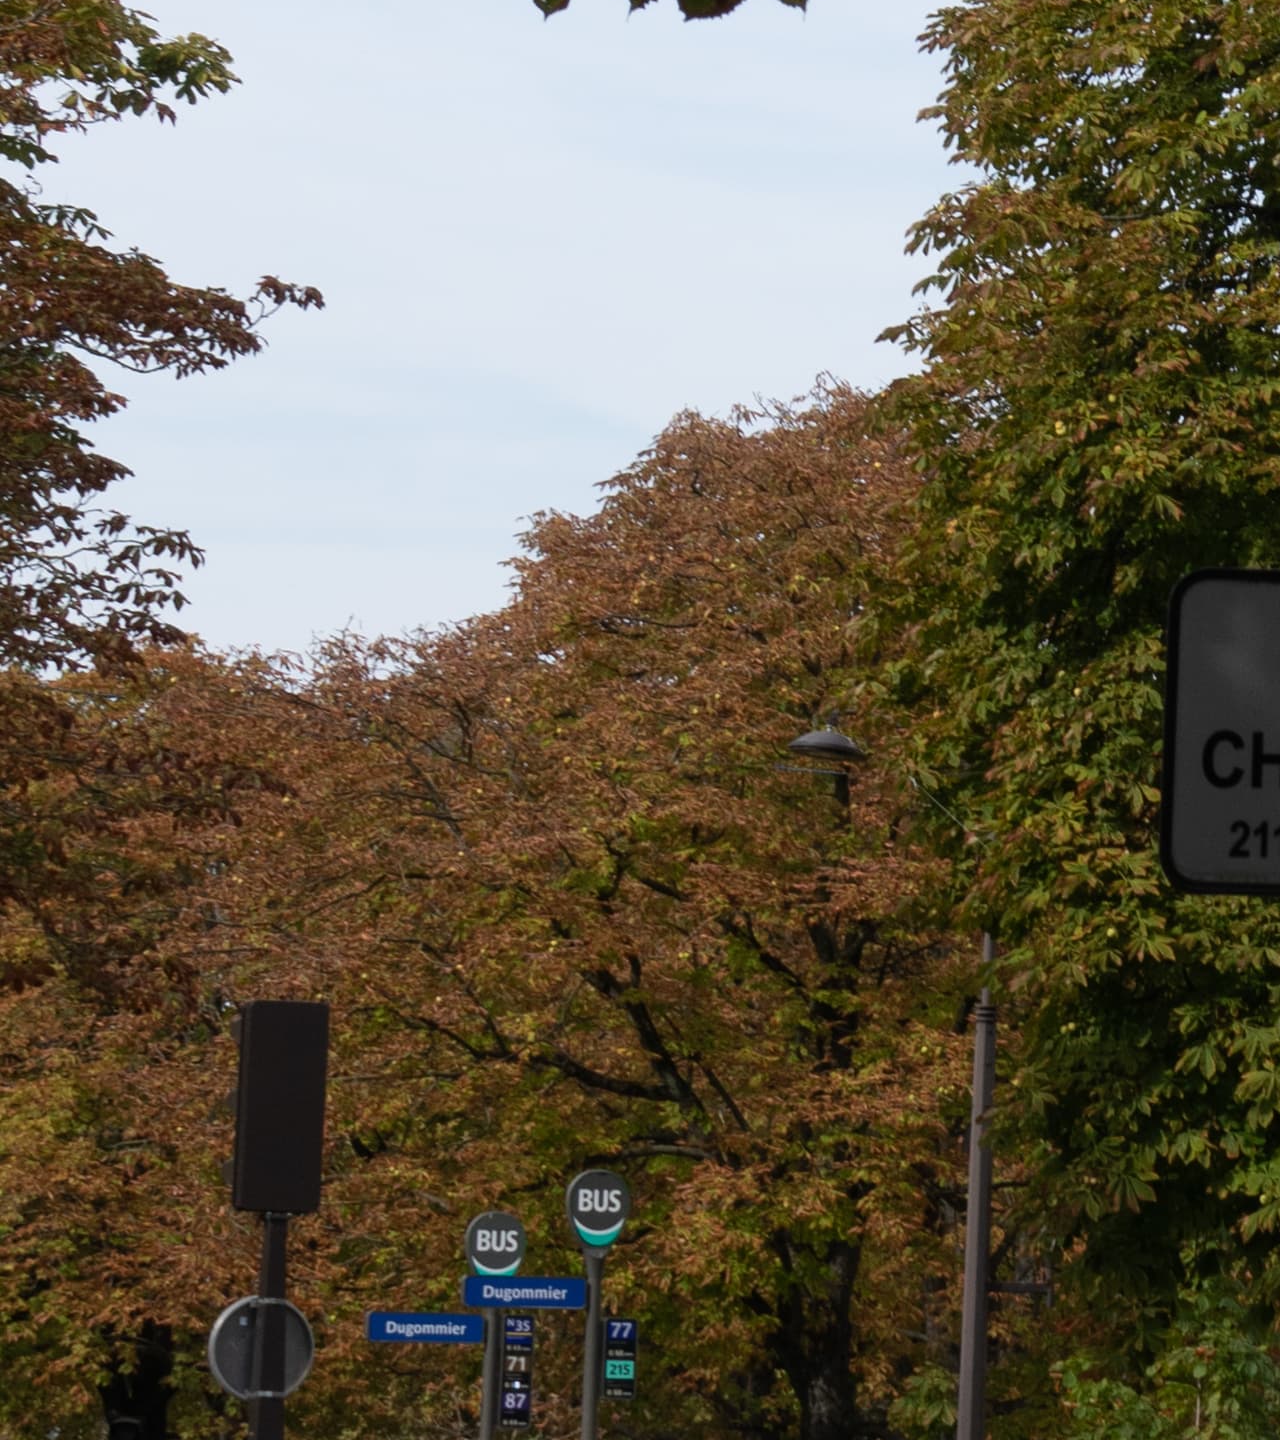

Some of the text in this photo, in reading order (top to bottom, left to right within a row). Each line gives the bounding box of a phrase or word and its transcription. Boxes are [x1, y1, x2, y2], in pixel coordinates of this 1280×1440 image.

[577, 1188, 622, 1213] BUS
[475, 1229, 519, 1252] BUS
[482, 1284, 568, 1302] Dugommier
[385, 1320, 467, 1339] Dugommier
[610, 1322, 632, 1338] 77
[506, 1355, 526, 1372] 71
[609, 1364, 631, 1376] 215
[504, 1392, 527, 1409] 87
